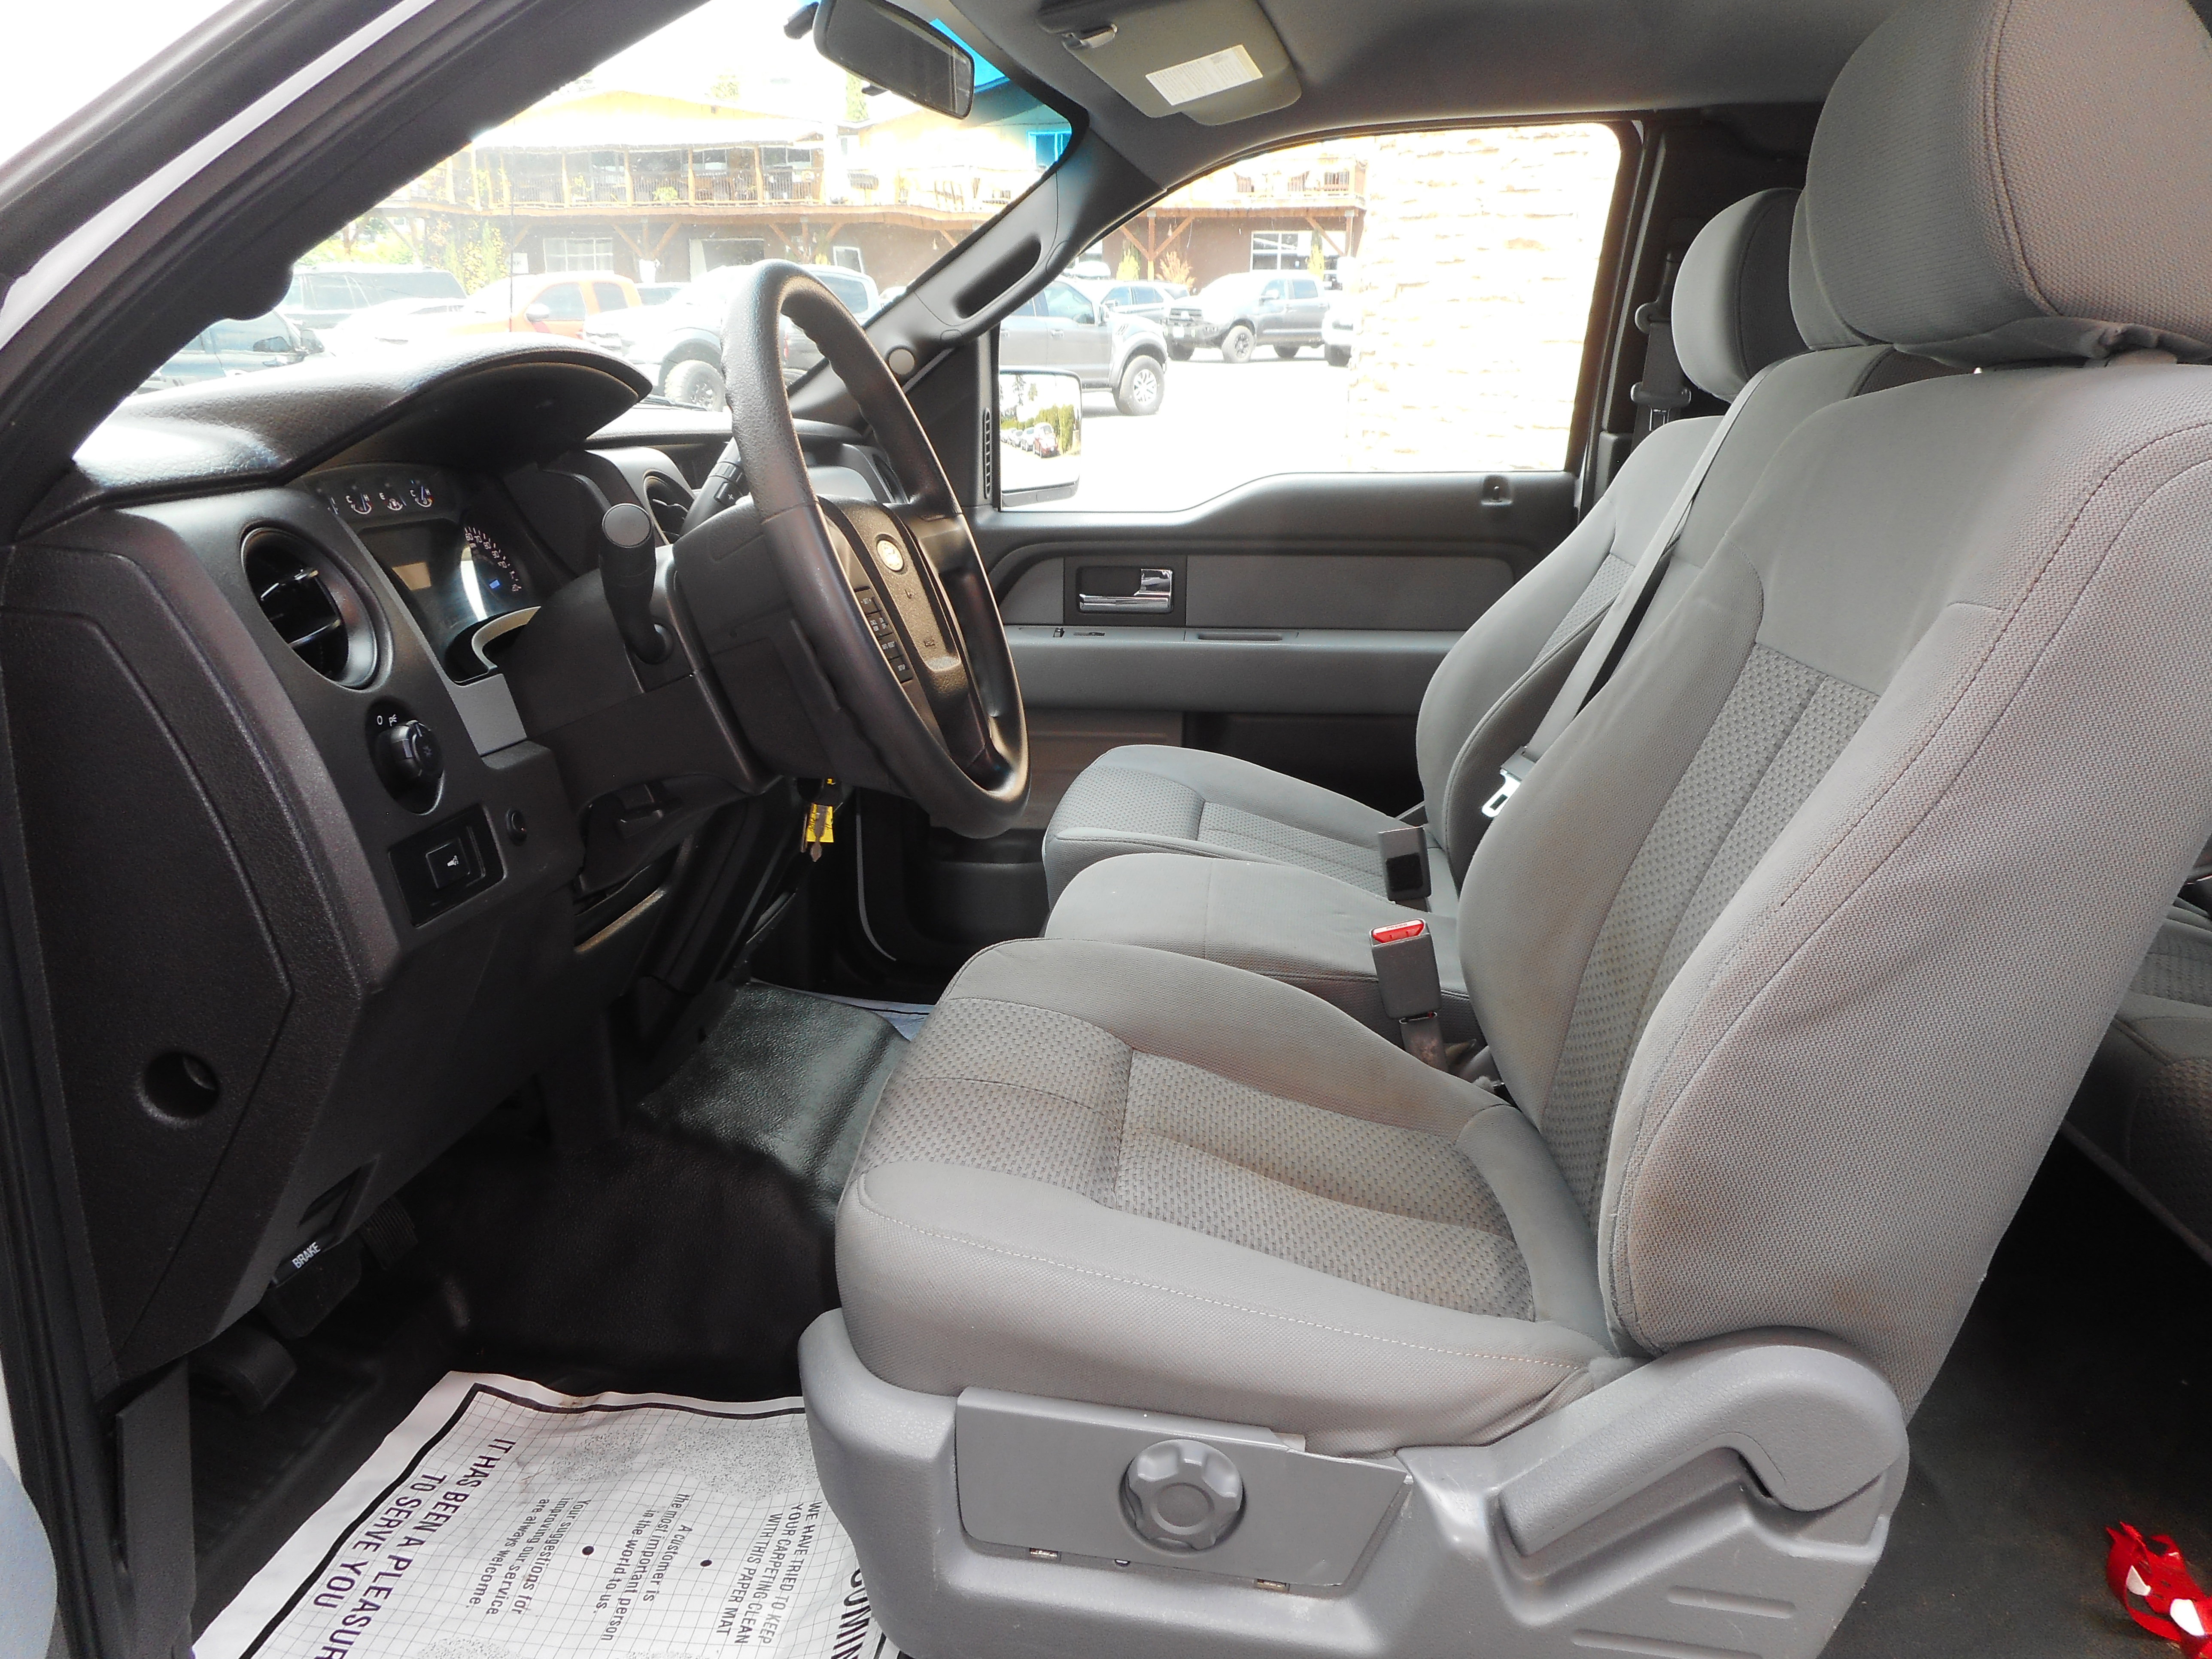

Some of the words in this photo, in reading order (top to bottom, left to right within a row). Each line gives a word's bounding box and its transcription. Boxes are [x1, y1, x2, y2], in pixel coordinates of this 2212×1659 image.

[292, 1241, 321, 1269] BRAKE
[487, 1438, 516, 1454] IT
[410, 1474, 447, 1492] TO
[456, 1455, 501, 1487] HAS
[413, 1491, 470, 1532] BEEN
[532, 1498, 550, 1513] are
[566, 1499, 592, 1519] Your
[642, 1510, 659, 1518] in
[671, 1493, 690, 1508] the
[805, 1501, 823, 1522] WE
[352, 1497, 422, 1553] SERVE
[505, 1516, 536, 1547] always
[526, 1498, 574, 1544] improving
[632, 1520, 652, 1535] the
[655, 1510, 678, 1533] most
[678, 1524, 693, 1532] A
[760, 1513, 784, 1538] WITH
[781, 1503, 804, 1537] YOUR
[396, 1536, 426, 1547] A
[515, 1546, 534, 1562] our
[747, 1540, 770, 1564] THIS
[793, 1524, 815, 1555] HAVE
[523, 1522, 572, 1591] suggestions
[613, 1539, 638, 1574] world
[624, 1535, 665, 1594] important
[650, 1534, 685, 1585] customer
[752, 1539, 792, 1600] CARPETING
[313, 1561, 369, 1608] YOU
[466, 1550, 510, 1608] welcome.
[486, 1564, 520, 1615] service
[605, 1579, 622, 1589] to
[728, 1567, 757, 1603] PAPER
[779, 1559, 805, 1592] TRIED
[511, 1594, 532, 1614] for
[593, 1594, 611, 1613] us.
[643, 1590, 659, 1601] is
[771, 1595, 790, 1610] TO
[601, 1598, 632, 1641] person
[716, 1607, 738, 1636] MAT
[734, 1602, 763, 1644] CLEAN
[758, 1613, 781, 1644] KEEP
